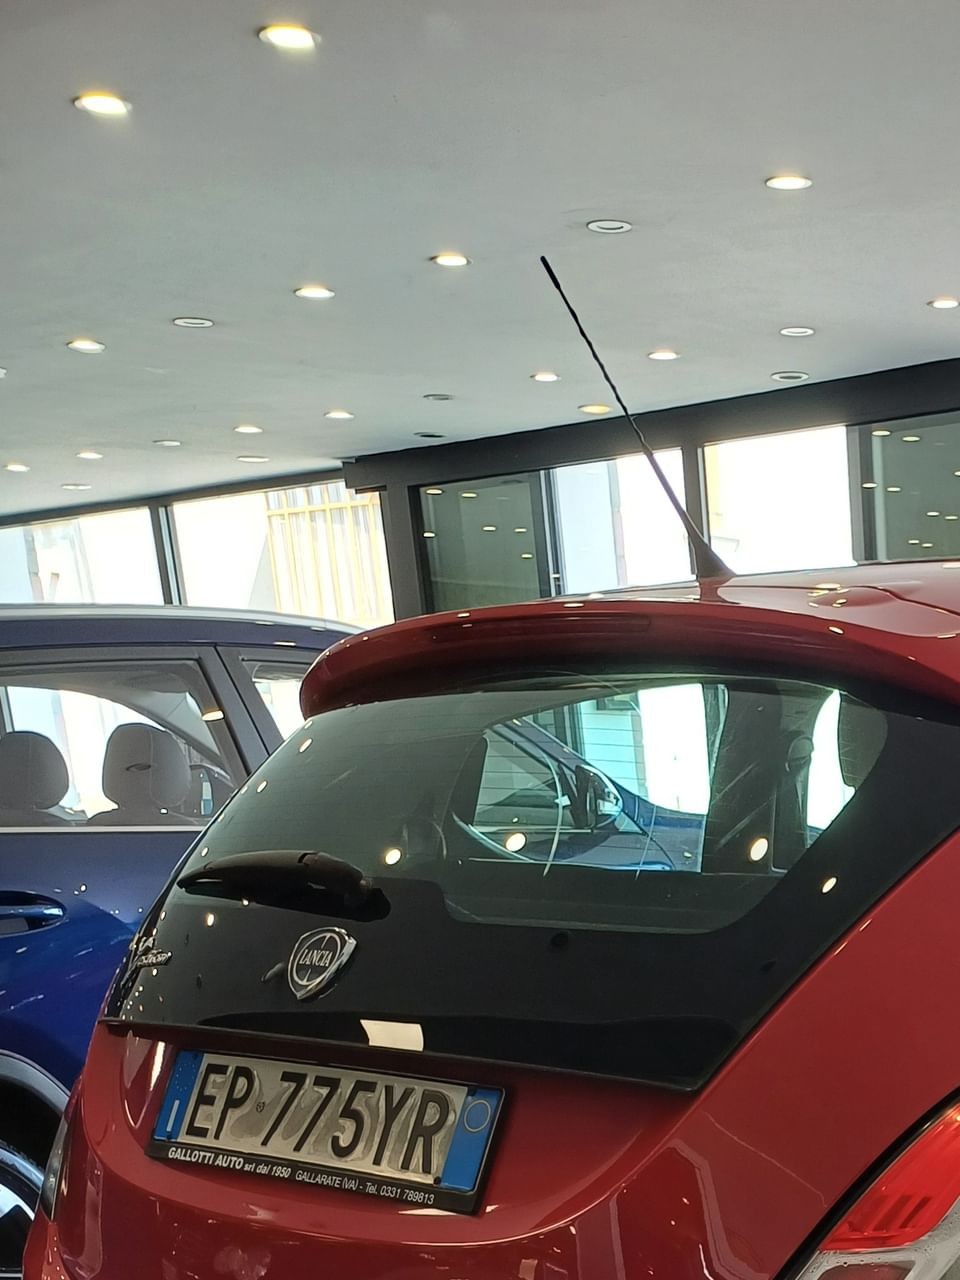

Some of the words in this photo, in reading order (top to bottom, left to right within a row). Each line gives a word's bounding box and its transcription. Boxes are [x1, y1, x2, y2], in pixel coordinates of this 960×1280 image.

[299, 949, 332, 967] LANCIA
[187, 1064, 255, 1140] EP
[261, 1071, 450, 1174] 775YR
[168, 1147, 215, 1165] GALLOTTI
[215, 1155, 244, 1169] AUTO
[256, 1163, 270, 1175] dal
[271, 1165, 291, 1178] 1950
[295, 1170, 342, 1188] GALLARATE
[342, 1177, 358, 1191] (VA)
[365, 1182, 378, 1194] Tel.
[380, 1185, 400, 1198] 0331
[403, 1189, 434, 1204] 789813
